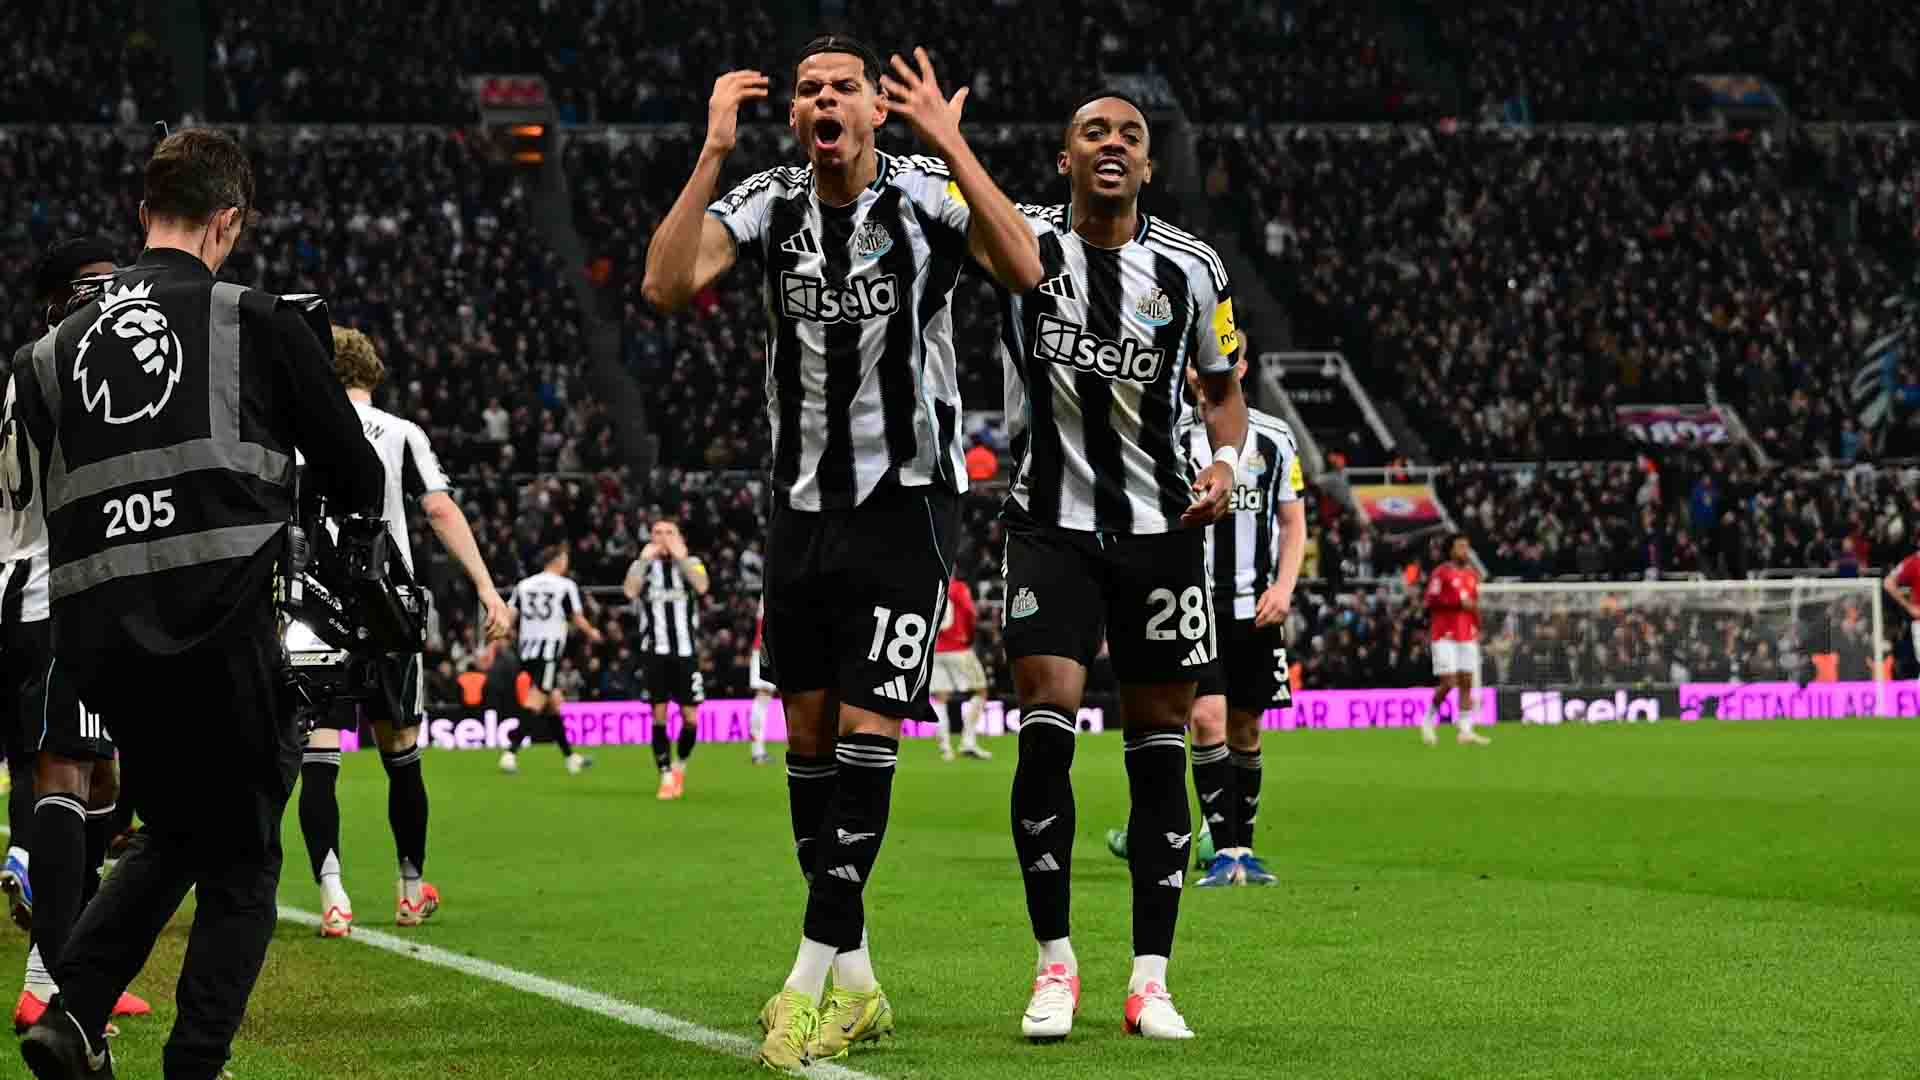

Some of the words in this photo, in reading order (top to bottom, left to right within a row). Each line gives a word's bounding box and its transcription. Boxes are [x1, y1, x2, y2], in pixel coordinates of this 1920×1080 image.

[820, 279, 896, 318] sela
[1075, 340, 1160, 378] sela
[103, 488, 176, 539] 205
[1228, 485, 1262, 511] ela
[523, 591, 554, 621] 33
[1145, 585, 1207, 641] 28
[867, 605, 927, 670] 18
